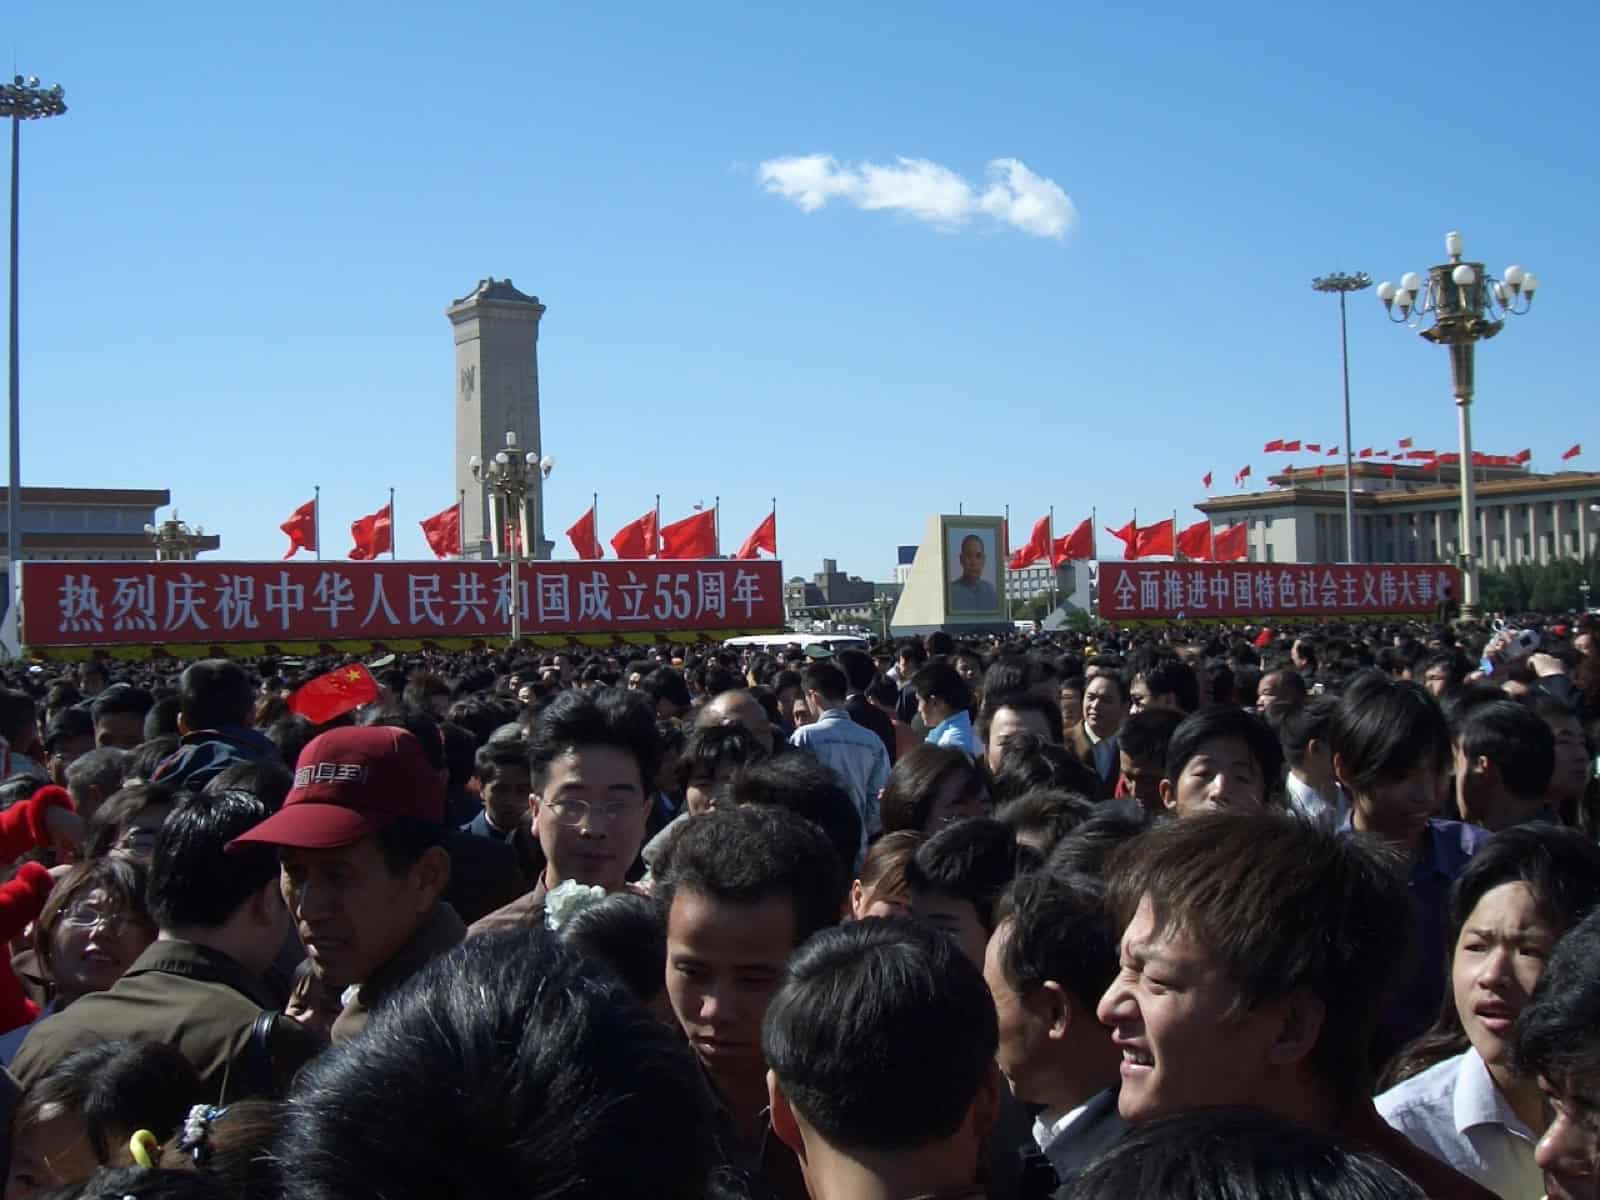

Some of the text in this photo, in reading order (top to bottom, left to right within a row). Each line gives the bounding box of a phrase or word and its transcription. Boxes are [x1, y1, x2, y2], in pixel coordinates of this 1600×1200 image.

[58, 569, 765, 633] 热烈庆祝中华人民共和国成立55周年
